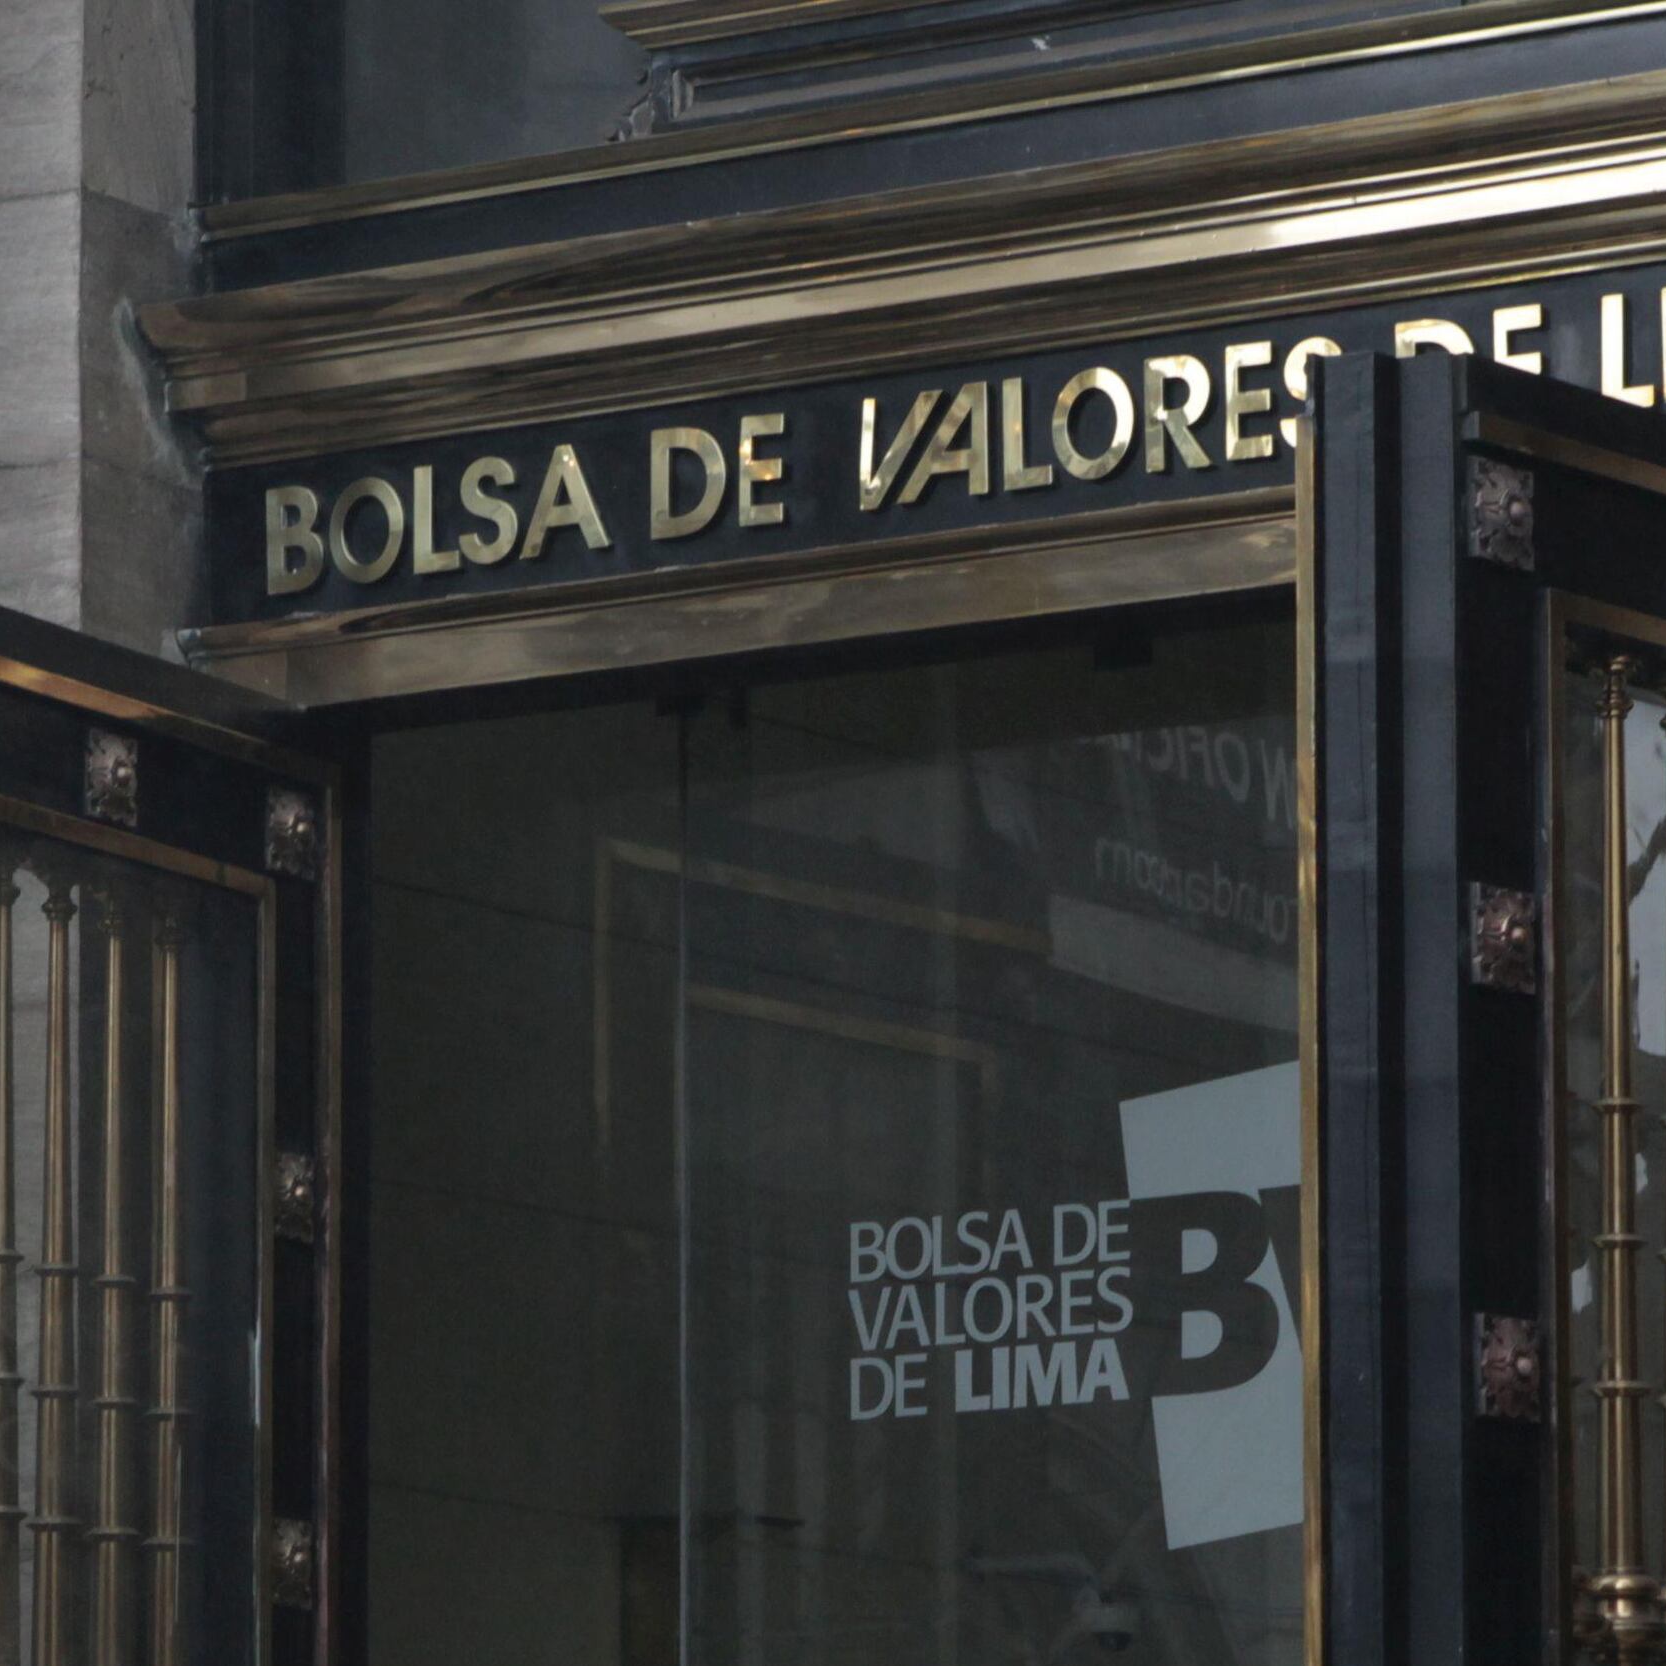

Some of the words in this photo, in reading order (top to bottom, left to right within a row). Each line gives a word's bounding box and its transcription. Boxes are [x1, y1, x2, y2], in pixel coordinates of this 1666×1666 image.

[265, 442, 611, 598] BOLSA
[649, 412, 786, 542] DE
[848, 1208, 1033, 1284] BOLSA
[1053, 1199, 1131, 1267] DE
[847, 1266, 1133, 1352] VALORES
[849, 1352, 928, 1422] DE
[954, 1338, 1131, 1414] LIMA
